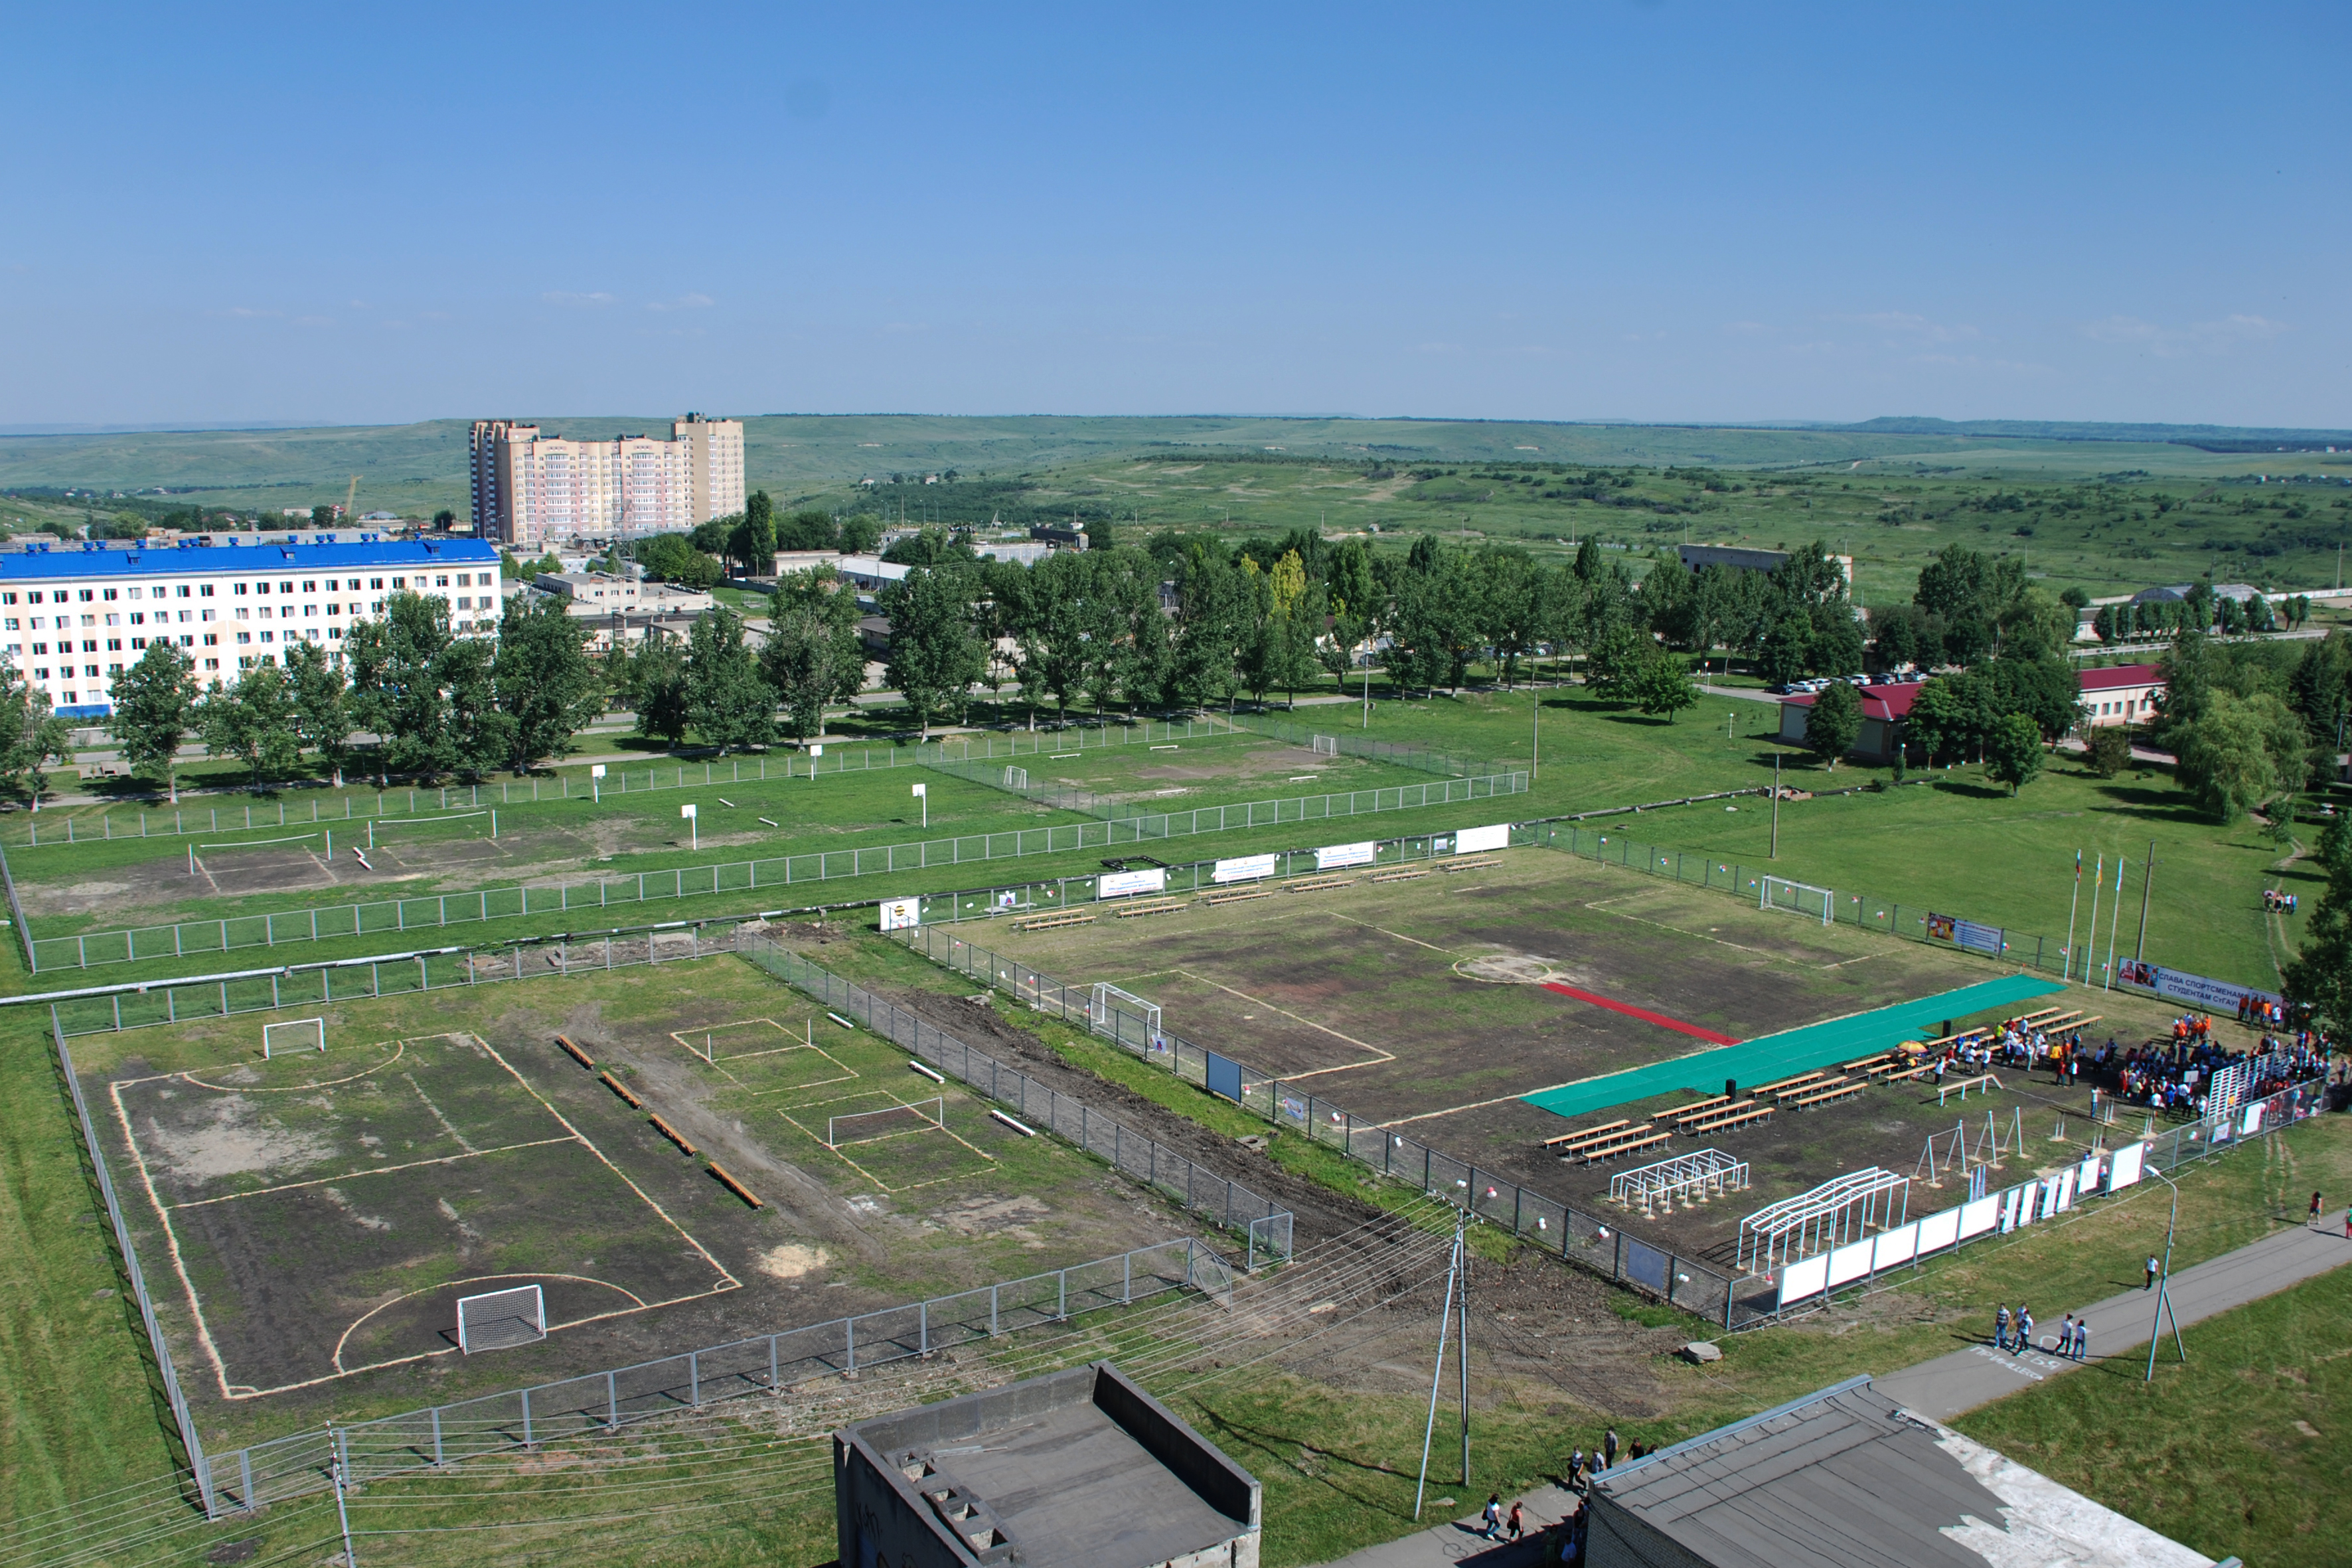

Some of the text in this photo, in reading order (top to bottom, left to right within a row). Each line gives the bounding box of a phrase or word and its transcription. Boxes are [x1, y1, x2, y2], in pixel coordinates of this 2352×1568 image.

[2158, 973, 2244, 998] СЛАВА СПОРТСМЕНАМ
[2167, 984, 2211, 1000] СТУДЕНТАМ
[2012, 1348, 2062, 1370] ЕБЯ
